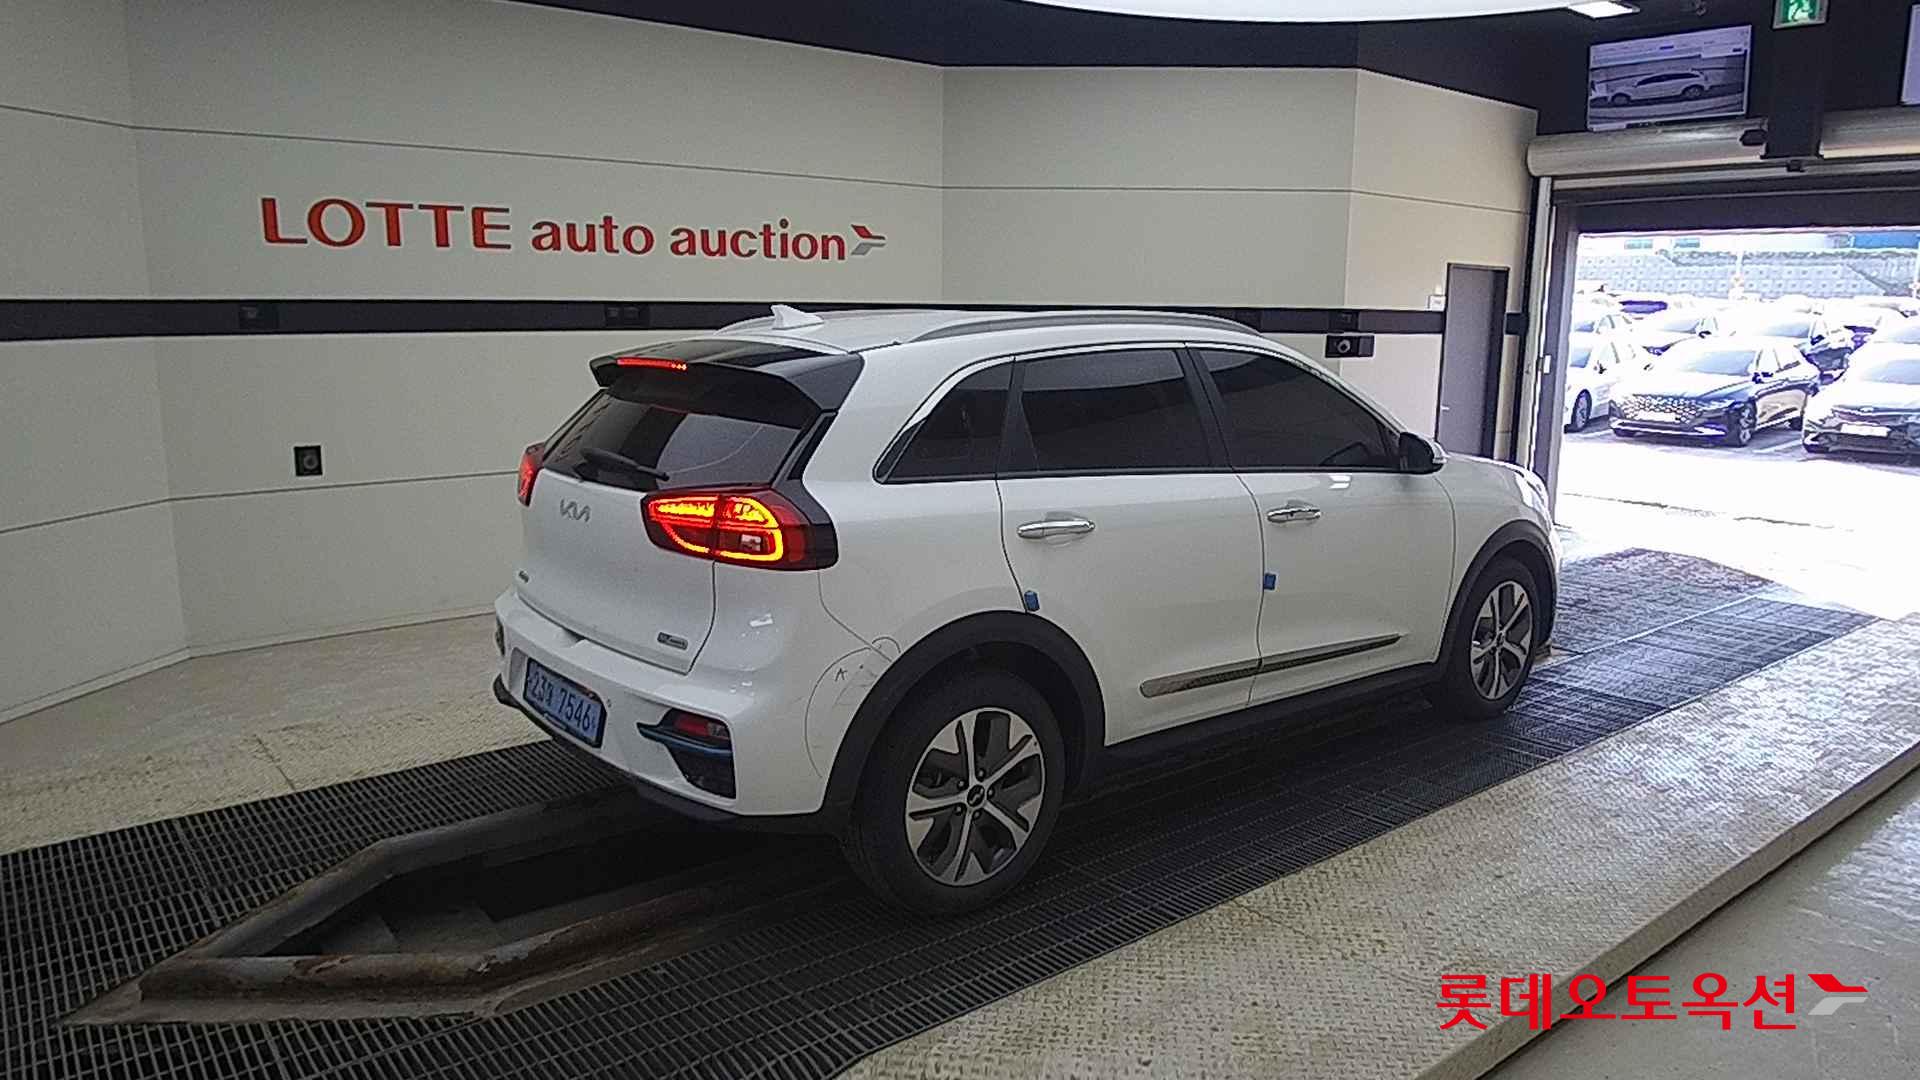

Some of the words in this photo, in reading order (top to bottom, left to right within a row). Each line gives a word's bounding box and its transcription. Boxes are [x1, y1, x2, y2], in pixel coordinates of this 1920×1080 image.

[261, 197, 512, 249] LOTTE
[531, 215, 655, 254] auto
[669, 218, 847, 262] auction
[558, 687, 592, 731] 7546
